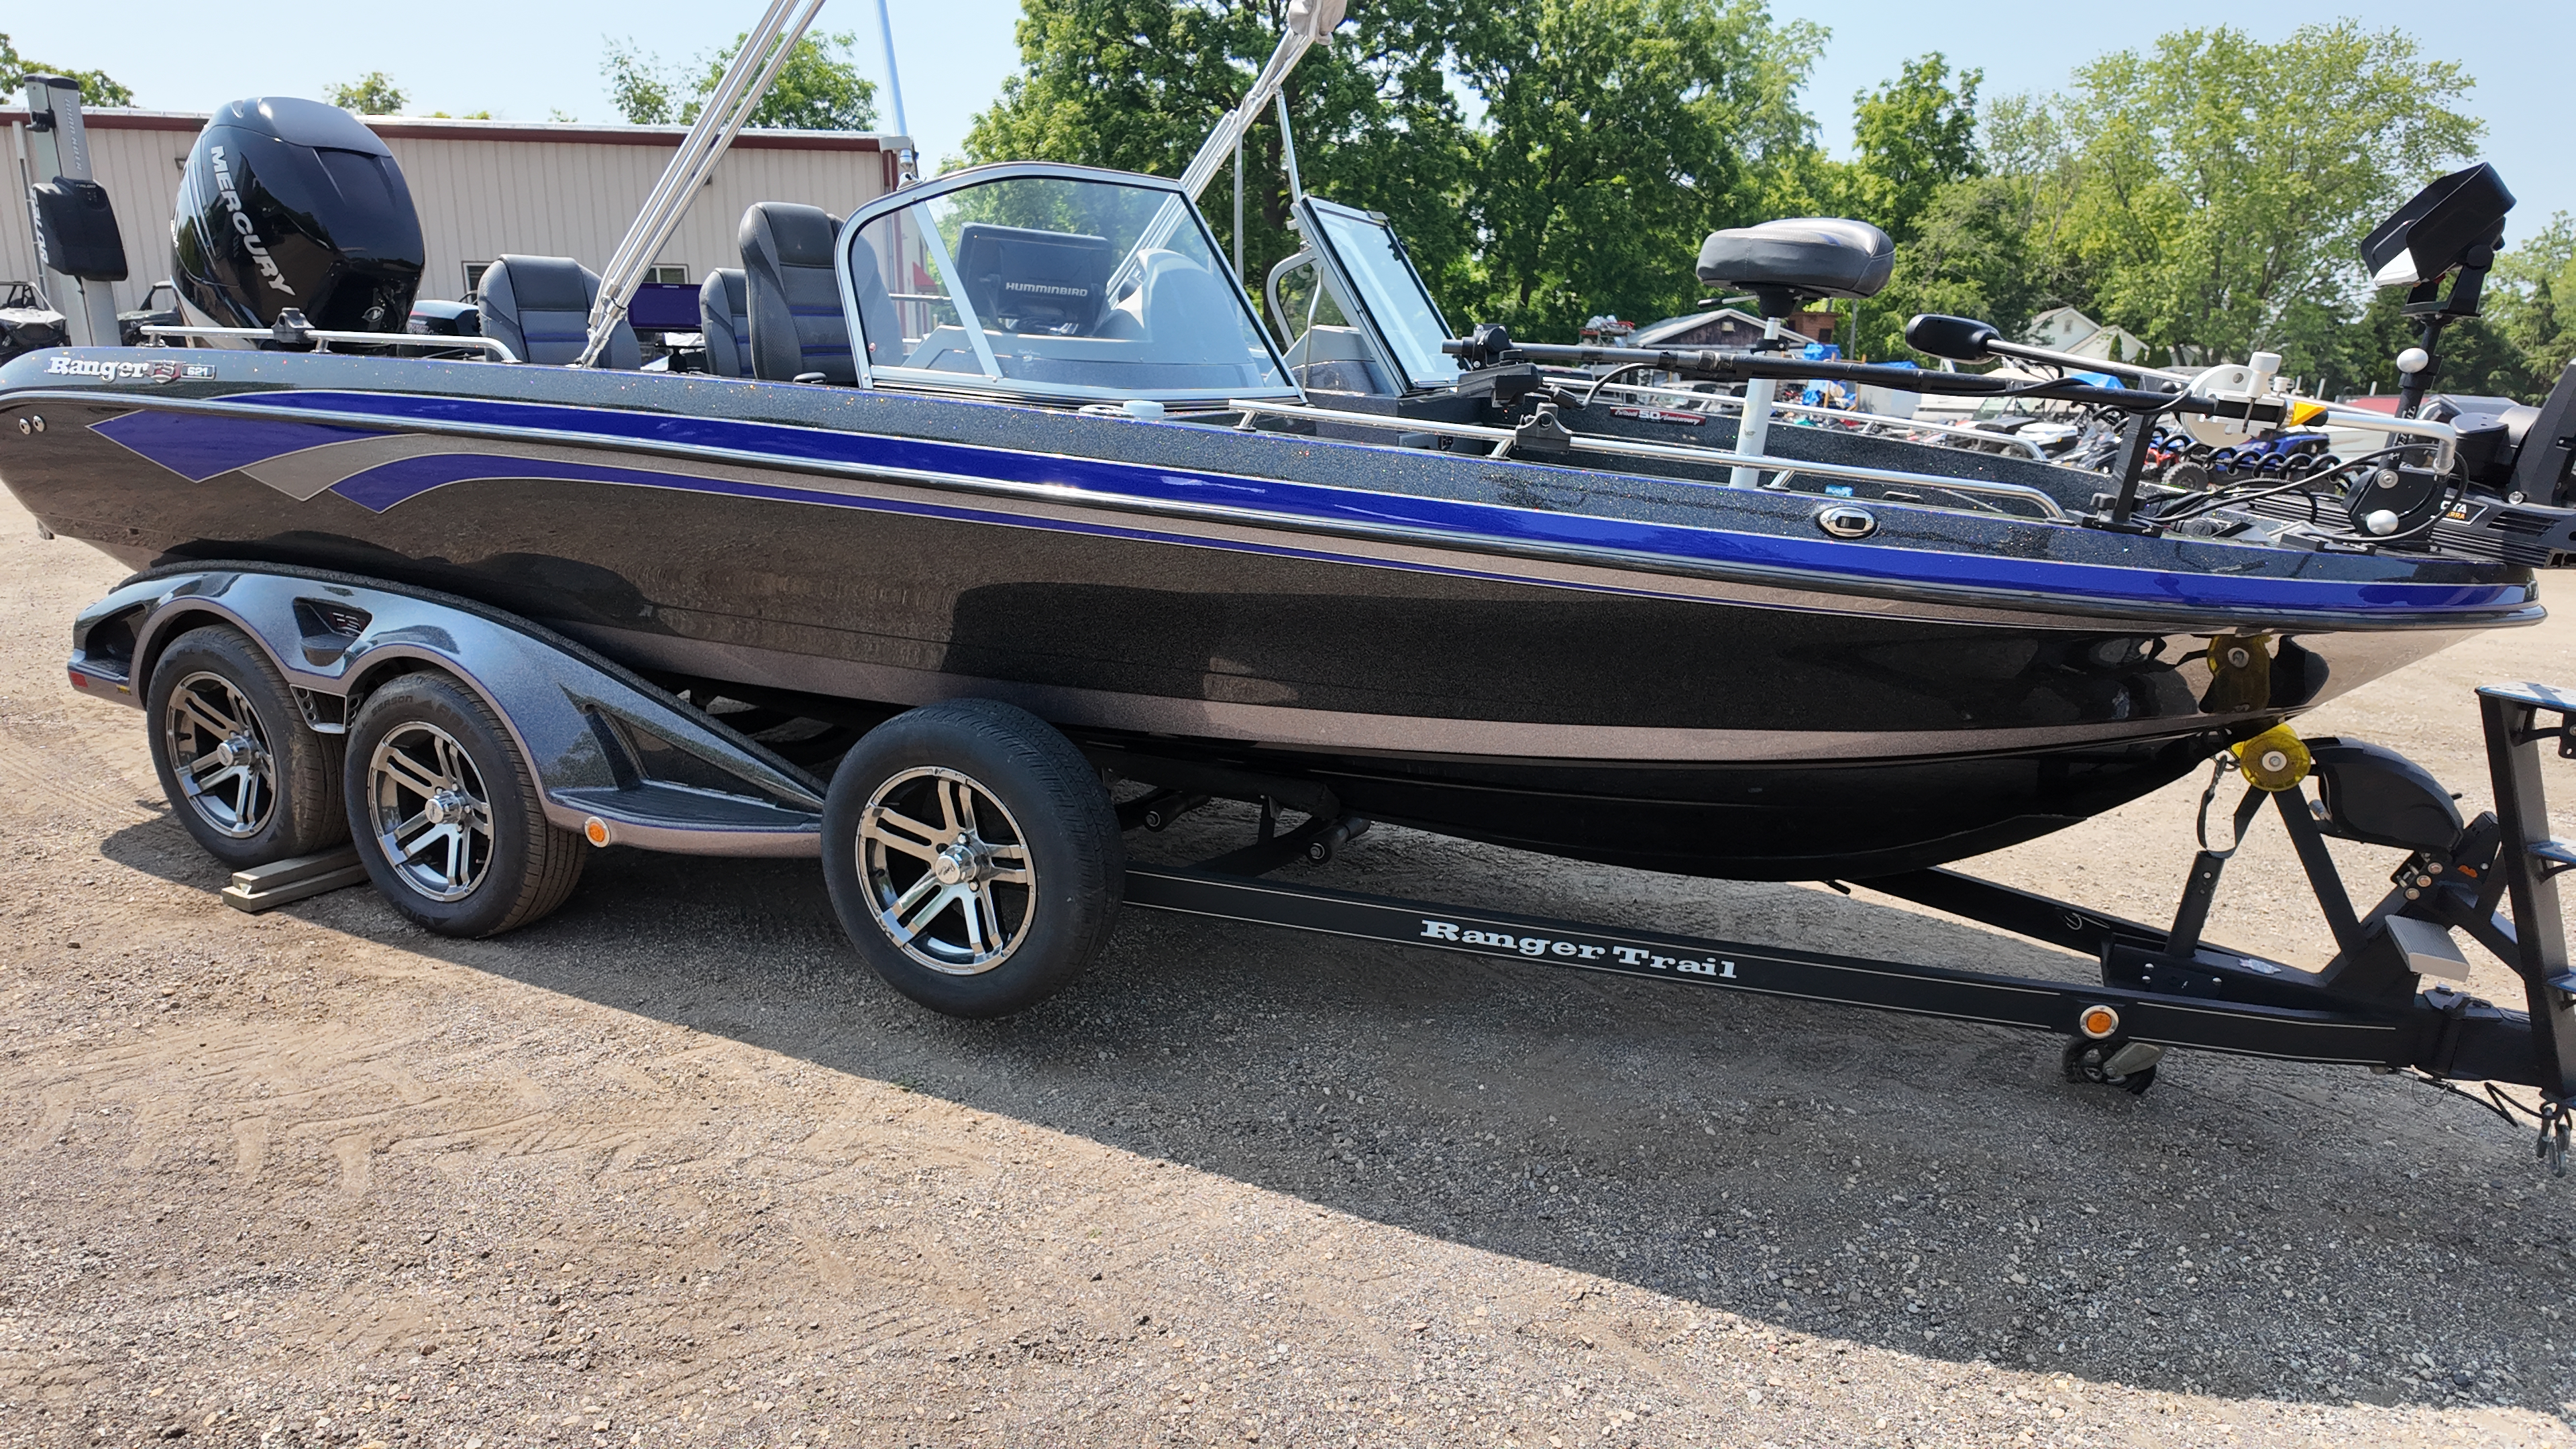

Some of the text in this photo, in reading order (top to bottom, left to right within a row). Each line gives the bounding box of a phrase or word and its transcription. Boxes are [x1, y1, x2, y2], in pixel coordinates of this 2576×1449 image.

[211, 146, 296, 296] MERCURY
[1006, 282, 1088, 297] HUMMINBIRD
[48, 357, 148, 381] Ranger
[187, 366, 208, 376] 621
[1420, 919, 1737, 979] Ranger Trail
